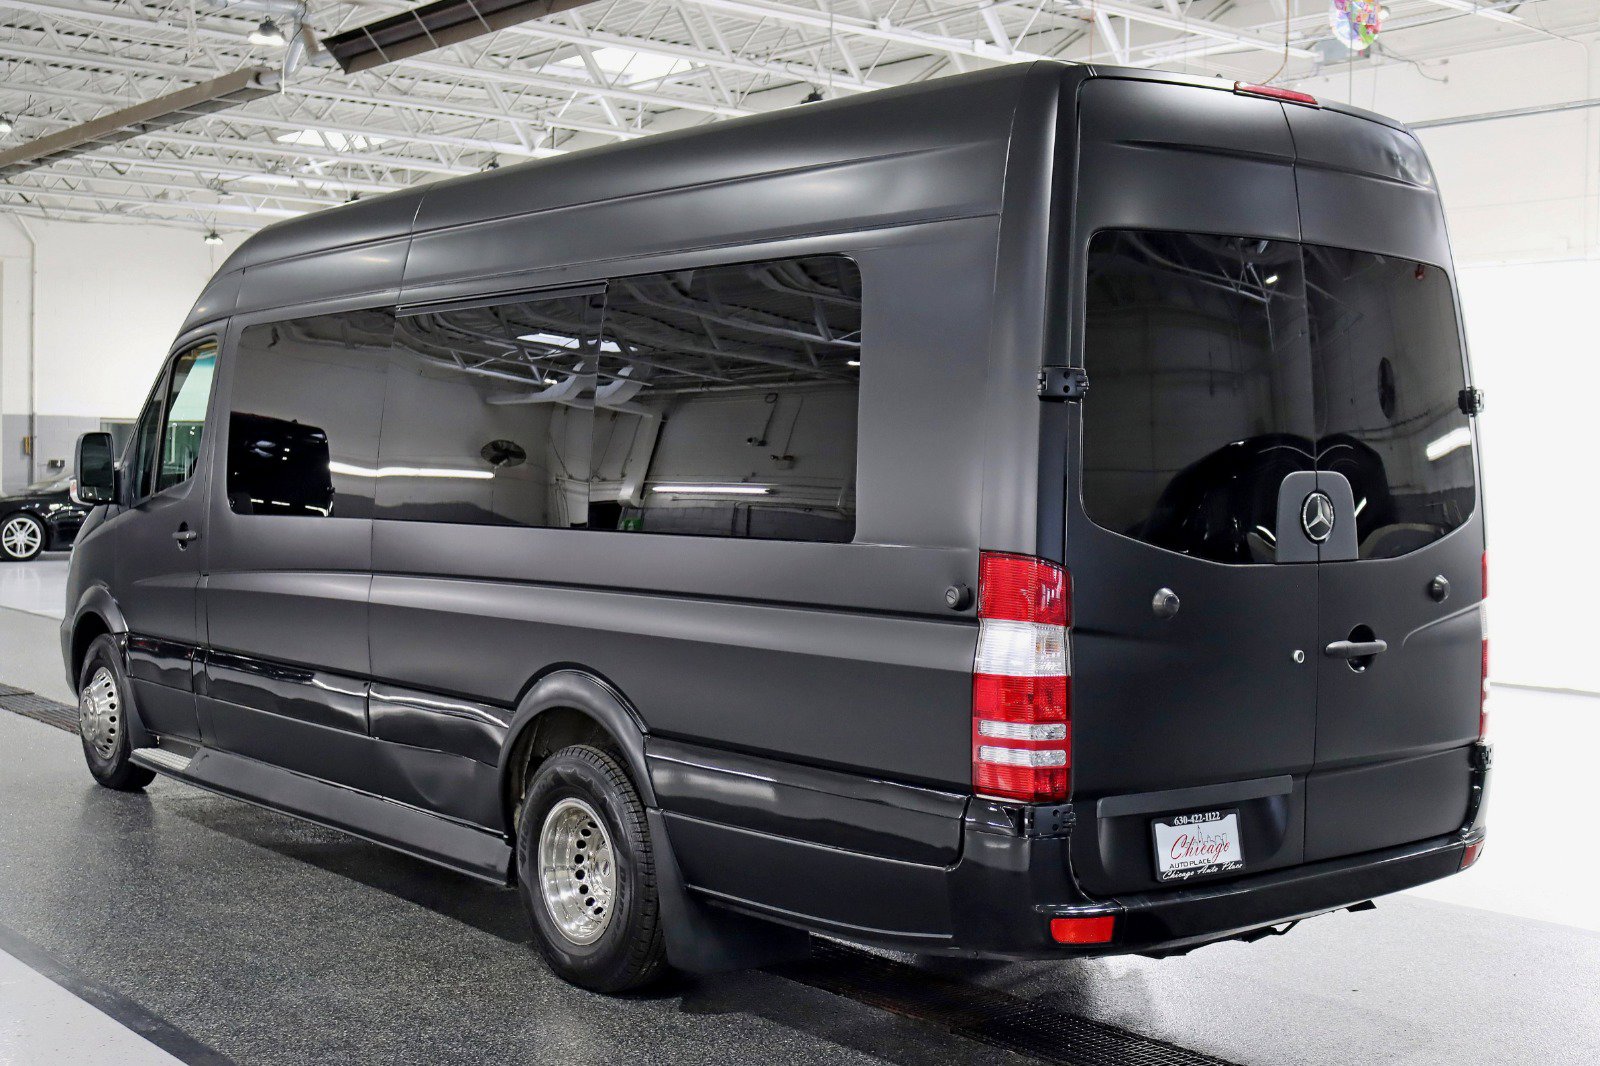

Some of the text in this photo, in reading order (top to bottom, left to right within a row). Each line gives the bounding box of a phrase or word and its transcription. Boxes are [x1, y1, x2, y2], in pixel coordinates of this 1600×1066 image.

[1174, 812, 1220, 825] 630-422-1122
[1171, 834, 1230, 863] Chicago
[1190, 858, 1211, 866] PLACE
[1162, 862, 1243, 880] Chicago Auto Place
